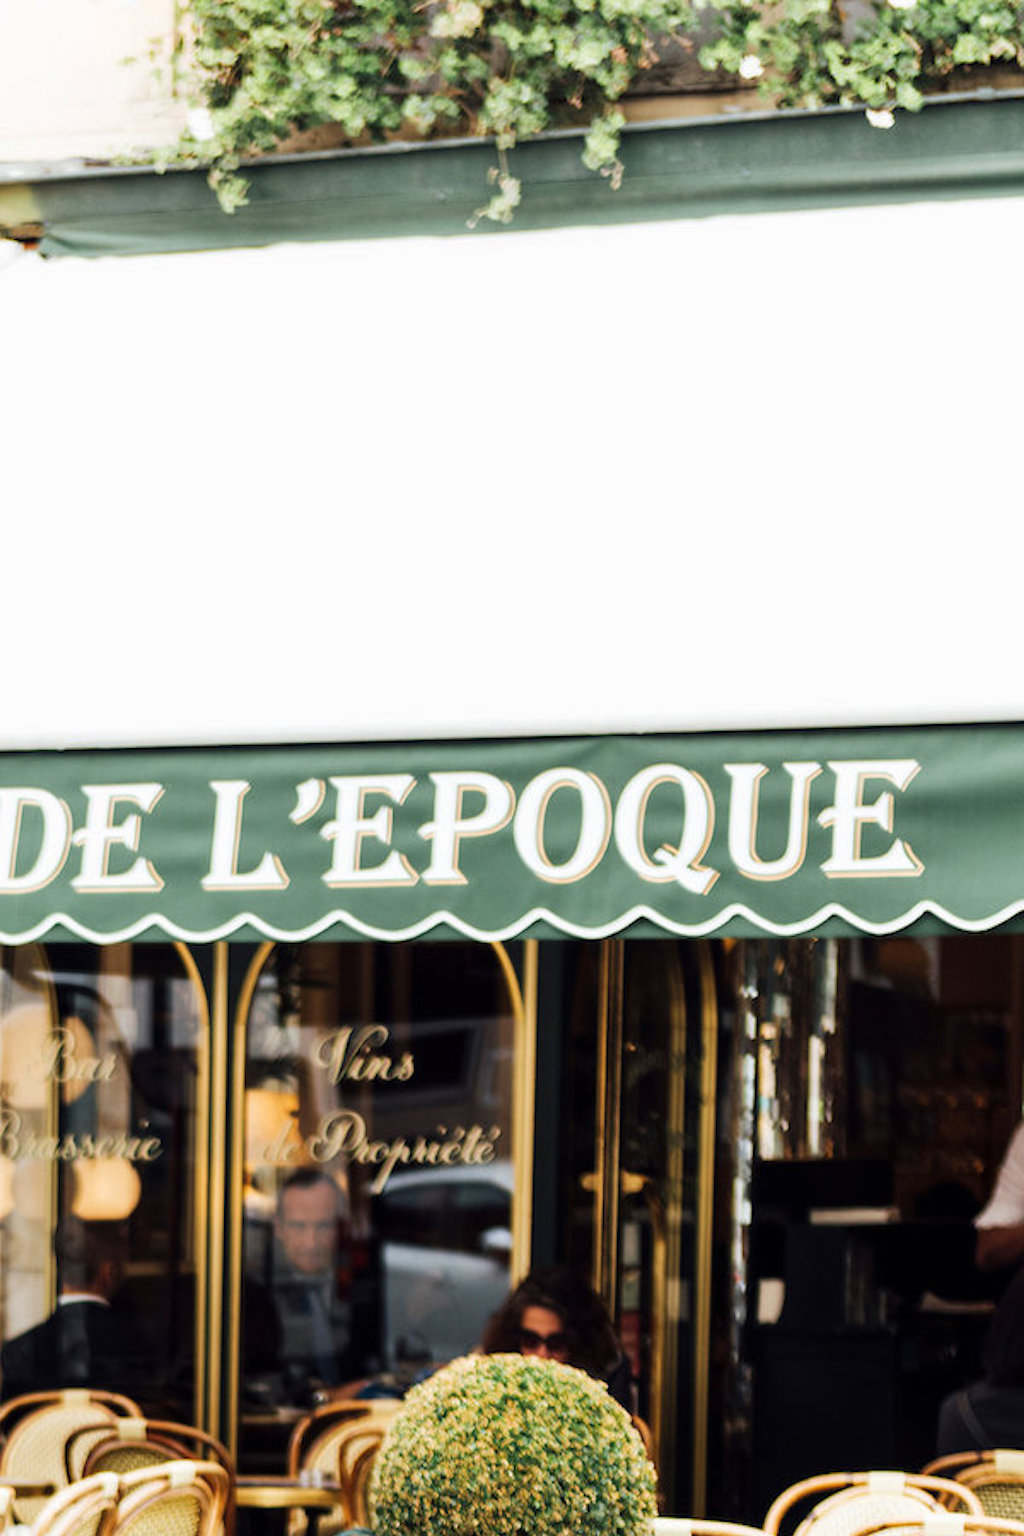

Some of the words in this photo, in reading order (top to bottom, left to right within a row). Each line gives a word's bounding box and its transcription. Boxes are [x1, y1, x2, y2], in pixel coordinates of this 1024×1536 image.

[201, 759, 925, 895] L'EPOQUE
[39, 1026, 118, 1083] Bar
[316, 1023, 416, 1084] Vins
[261, 1117, 301, 1164] de
[309, 1110, 501, 1195] Propriété
